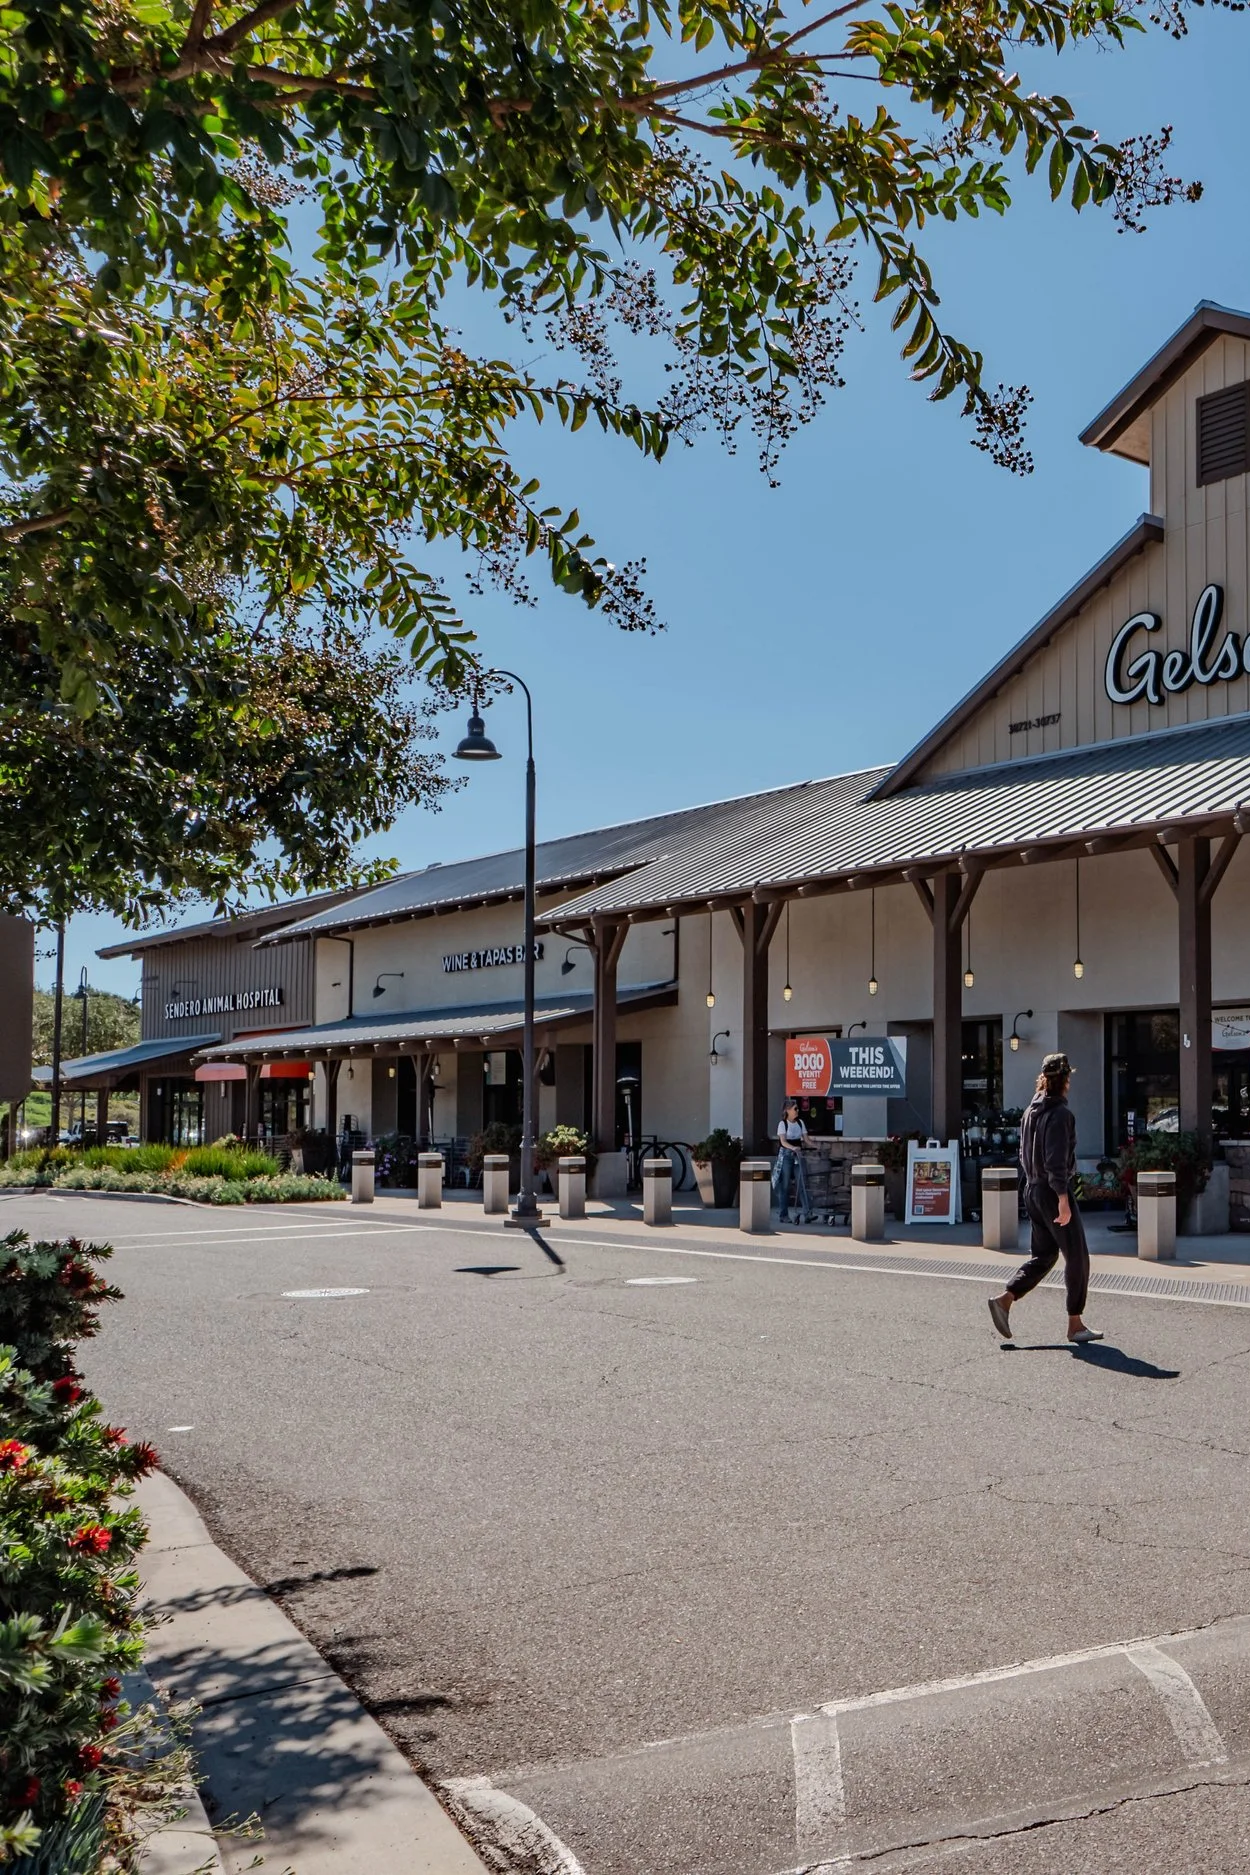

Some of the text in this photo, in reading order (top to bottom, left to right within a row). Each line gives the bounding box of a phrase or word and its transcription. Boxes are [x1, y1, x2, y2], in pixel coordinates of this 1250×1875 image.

[442, 943, 541, 972] WINE & TAPAS BR
[165, 988, 281, 1019] SENDERO ANIMAL HOSPITAL
[1214, 1015, 1244, 1023] WELCOME
[794, 1053, 825, 1070] BOGO
[848, 1046, 885, 1065] THIS
[839, 1066, 894, 1079] WEEKEND!
[802, 1081, 817, 1089] FREE
